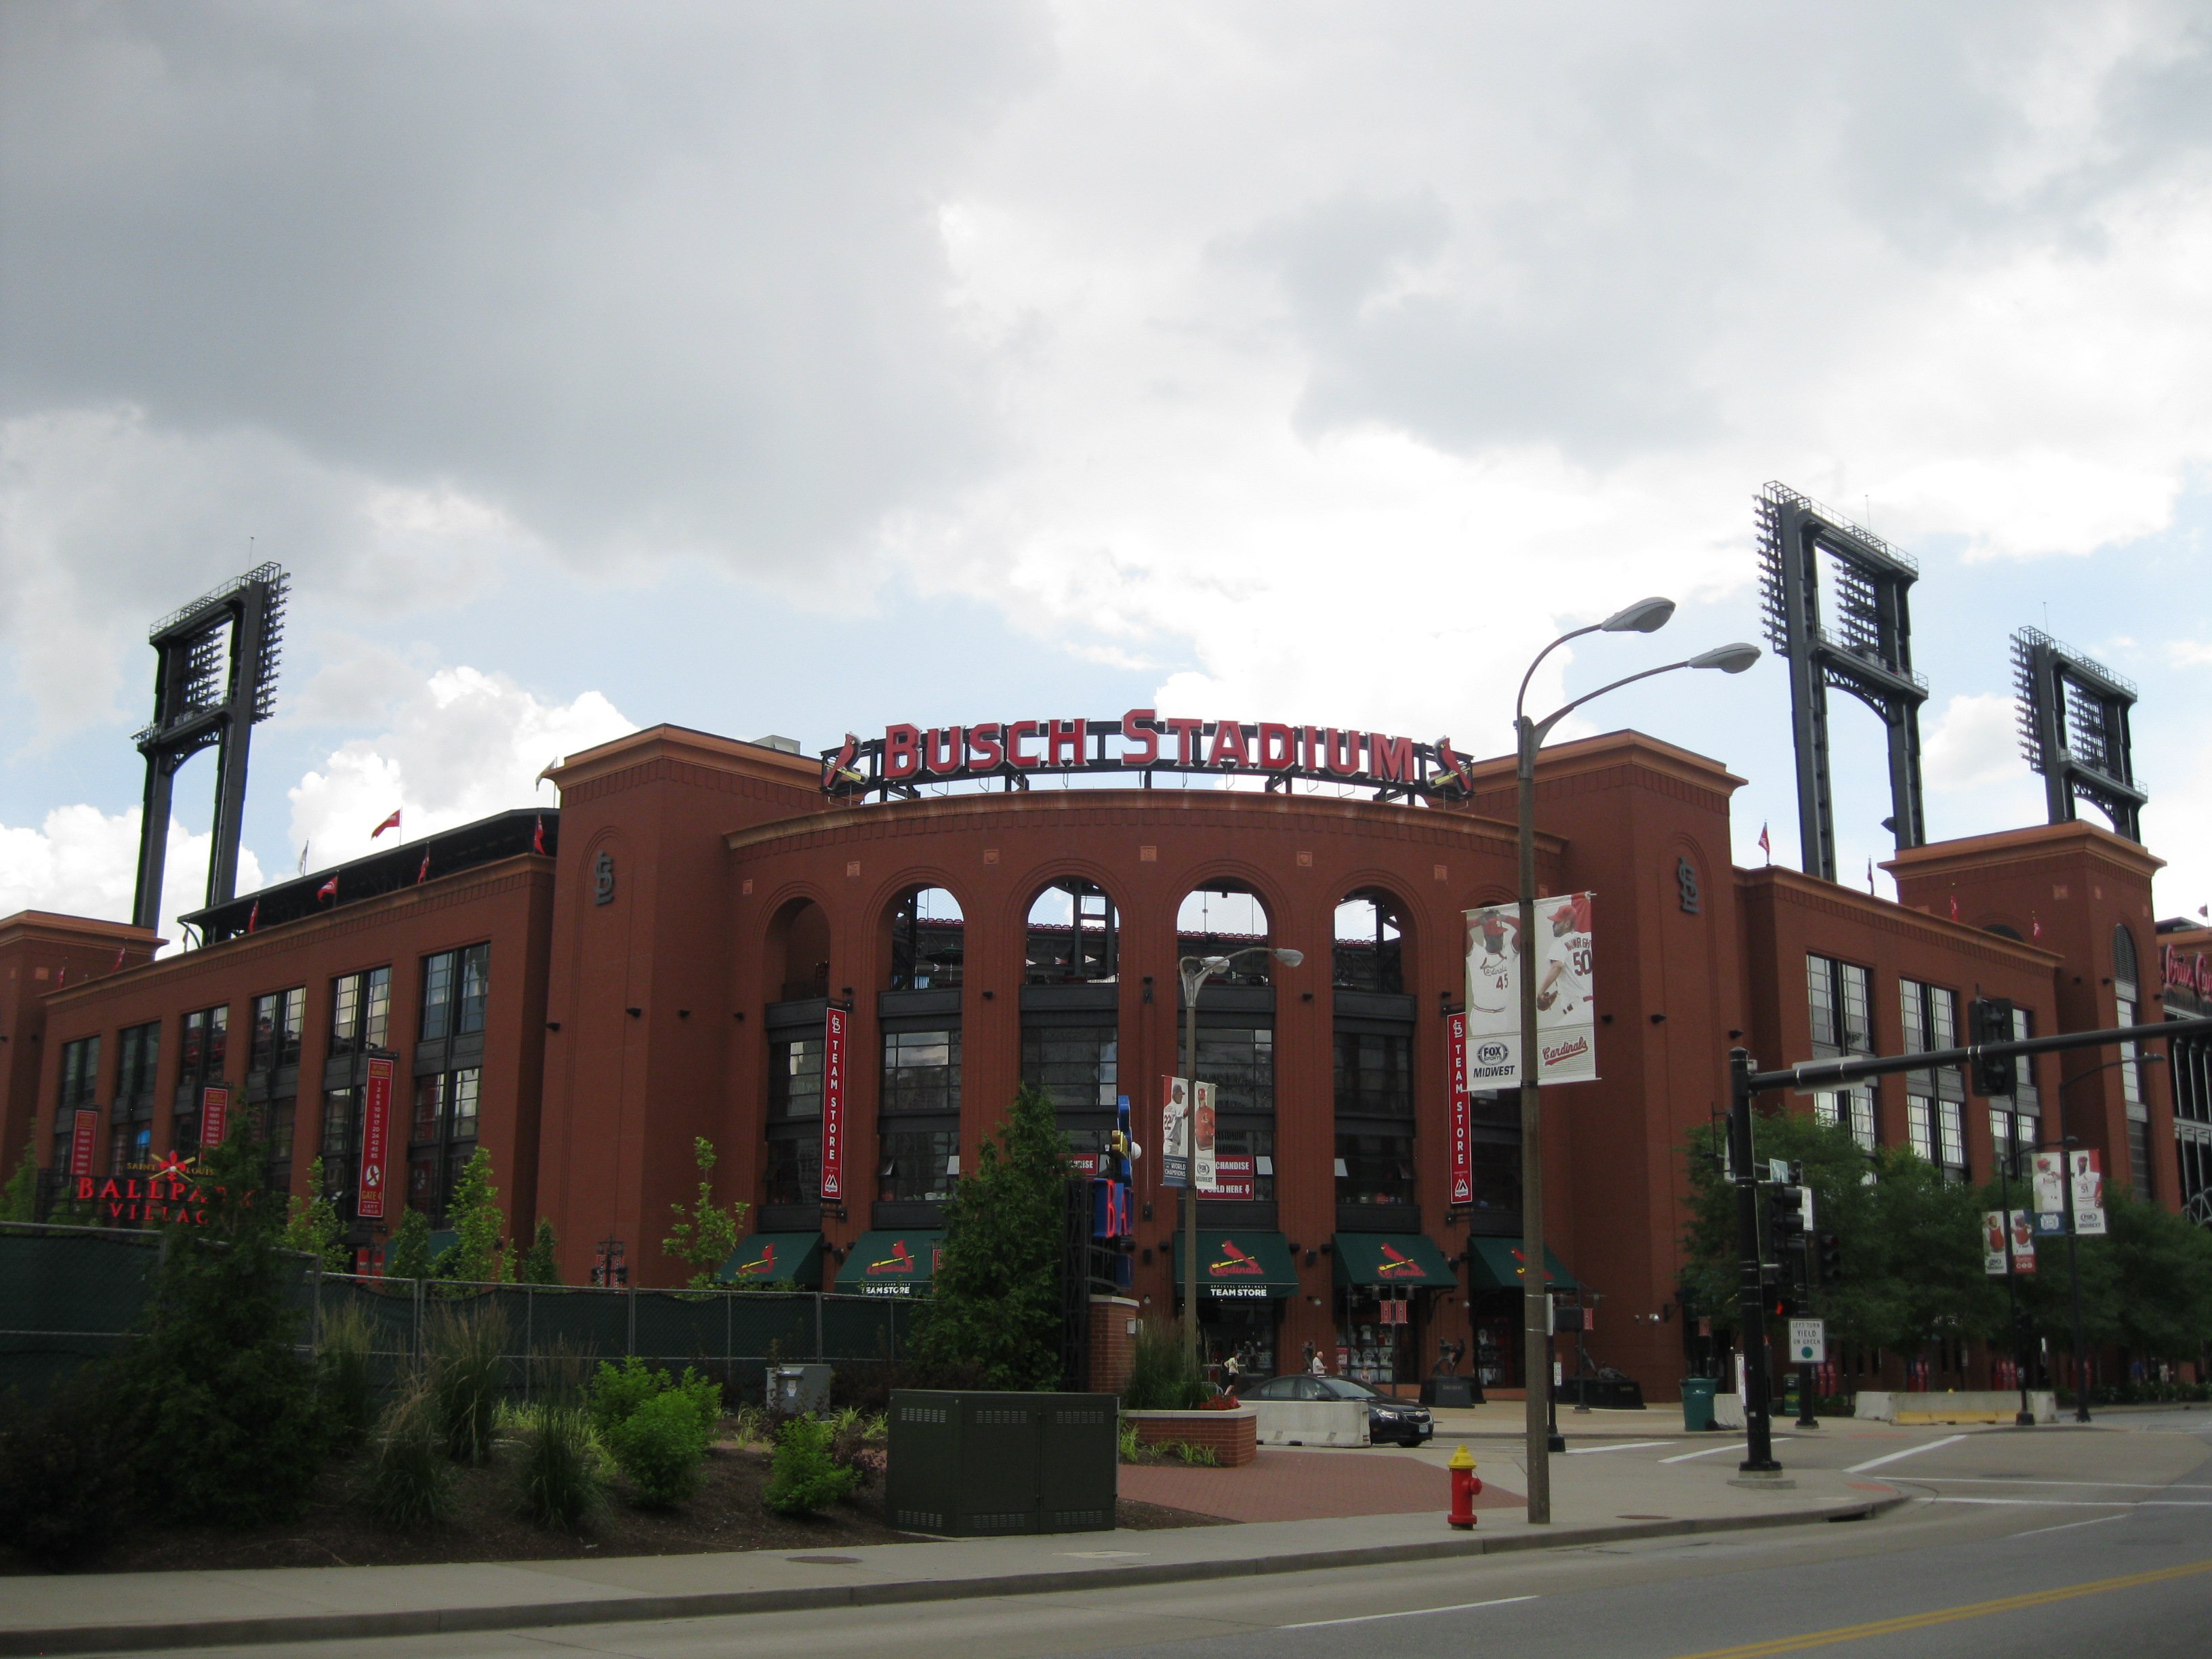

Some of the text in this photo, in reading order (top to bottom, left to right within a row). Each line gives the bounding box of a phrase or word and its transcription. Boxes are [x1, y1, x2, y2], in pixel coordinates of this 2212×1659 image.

[884, 708, 1414, 782] BUSCH STADIUM
[1573, 949, 1593, 976] 50
[1496, 973, 1509, 990] 45
[1483, 1046, 1501, 1057] FOX
[1542, 1036, 1588, 1066] Cardinals
[830, 1040, 839, 1090] TEAM
[1455, 1044, 1463, 1094] TEAM
[1473, 1065, 1515, 1078] MIDWEST
[829, 1097, 837, 1160] STORE
[126, 1162, 155, 1171] SAINT
[1171, 1162, 1186, 1170] WORLD
[1216, 1161, 1250, 1170] CHANDISE
[1164, 1168, 1186, 1177] CHAMPIONS
[1226, 1185, 1243, 1193] HERE
[1210, 1288, 1267, 1296] TEAM STORE
